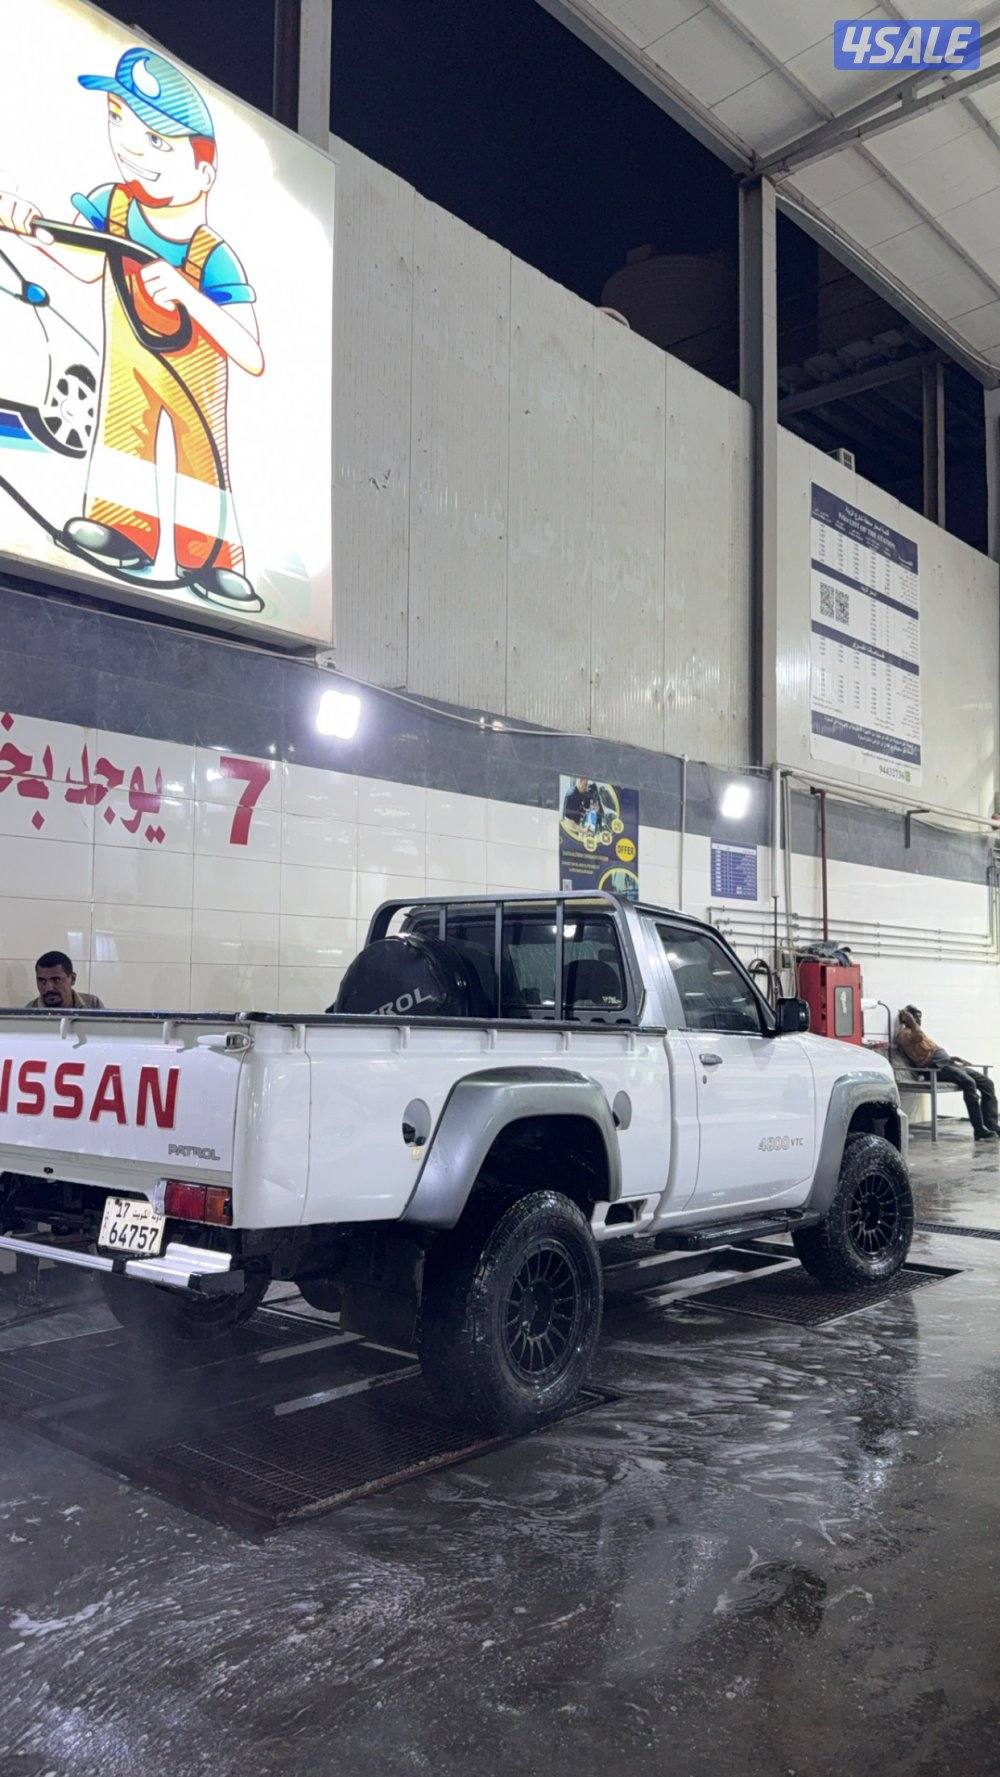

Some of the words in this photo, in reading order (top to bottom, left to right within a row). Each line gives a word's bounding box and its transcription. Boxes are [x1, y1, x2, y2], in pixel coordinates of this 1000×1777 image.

[0, 711, 54, 830] بخ
[64, 743, 166, 844] يوجد
[220, 755, 271, 845] 7
[617, 845, 634, 856] OFFER
[369, 987, 432, 1017] ROL
[0, 1058, 180, 1129] ISSAN
[168, 1143, 221, 1161] PATROL
[790, 1137, 804, 1146] VTC
[115, 1202, 131, 1218] 17
[109, 1221, 160, 1251] 64757
